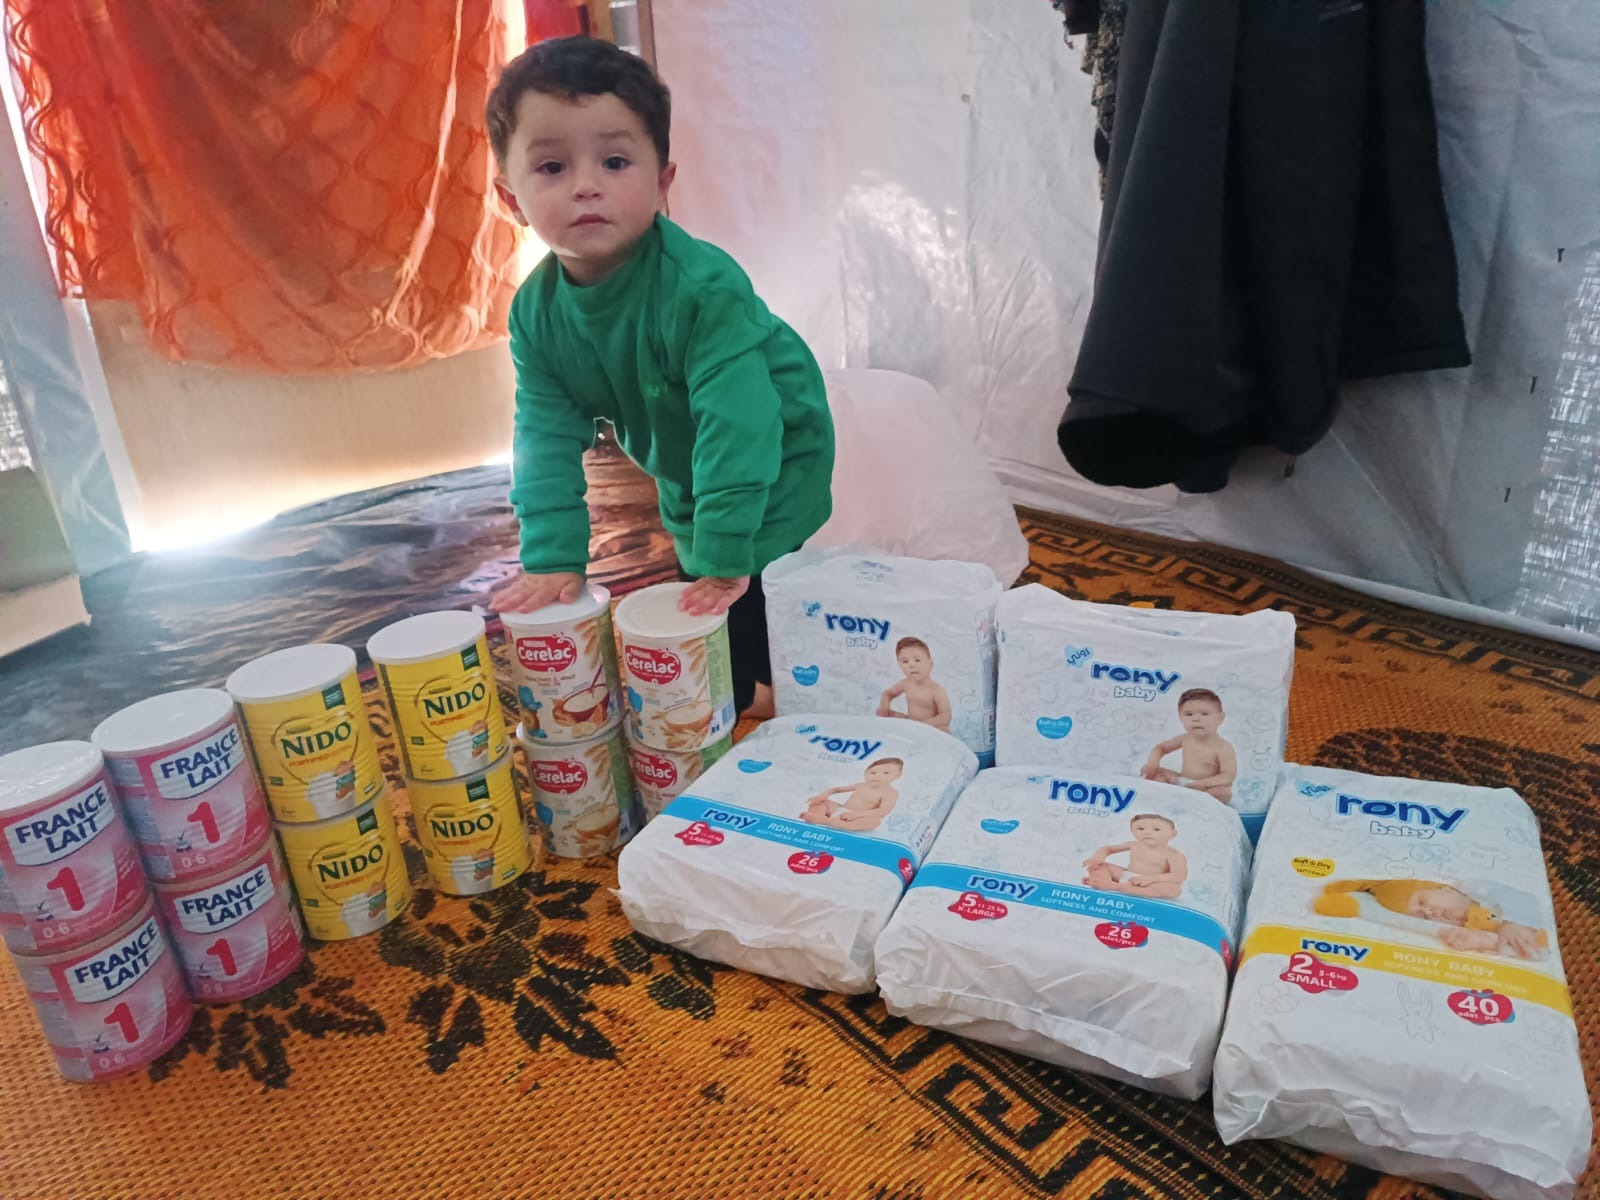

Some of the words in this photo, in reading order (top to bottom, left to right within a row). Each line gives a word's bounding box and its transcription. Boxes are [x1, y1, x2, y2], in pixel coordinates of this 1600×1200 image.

[825, 613, 891, 641] rony
[846, 637, 879, 650] baby
[1093, 663, 1179, 692] rony
[1114, 685, 1157, 703] baby
[423, 682, 486, 718] NIDO
[160, 728, 239, 779] FRANCE
[280, 721, 352, 759] NIDO
[809, 734, 882, 760] rony
[187, 753, 231, 788] LAIT
[1051, 780, 1135, 813] rony
[1338, 795, 1466, 832] rony
[15, 786, 107, 844] FRANCE
[187, 802, 221, 843] 1
[430, 813, 494, 838] NIDO
[688, 822, 706, 836] 5
[703, 808, 758, 830] rony
[768, 822, 800, 836] RONY
[802, 830, 833, 843] BABY
[1370, 820, 1436, 840] baby
[45, 812, 99, 854] LAIT
[317, 844, 383, 882] NIDO
[798, 854, 820, 867] 26
[47, 866, 86, 911] 1
[182, 869, 266, 914] FRANCE
[962, 893, 978, 907] 5
[969, 874, 1037, 900] rony
[1051, 889, 1091, 903] RONY
[1096, 897, 1135, 911] BABY
[206, 893, 256, 926] LAIT
[1088, 906, 1109, 915] AND
[1110, 910, 1156, 924] COMFORT
[1108, 926, 1132, 939] 26
[74, 922, 158, 983] FRANCE
[102, 949, 150, 991] LAIT
[207, 938, 238, 976] 1
[1291, 953, 1314, 975] 2
[1302, 939, 1369, 961] rony
[1393, 951, 1441, 968] RONY
[1449, 961, 1496, 978] BABY
[1287, 972, 1338, 989] SMALL
[104, 1002, 140, 1043] 1
[1458, 995, 1500, 1017] 40
